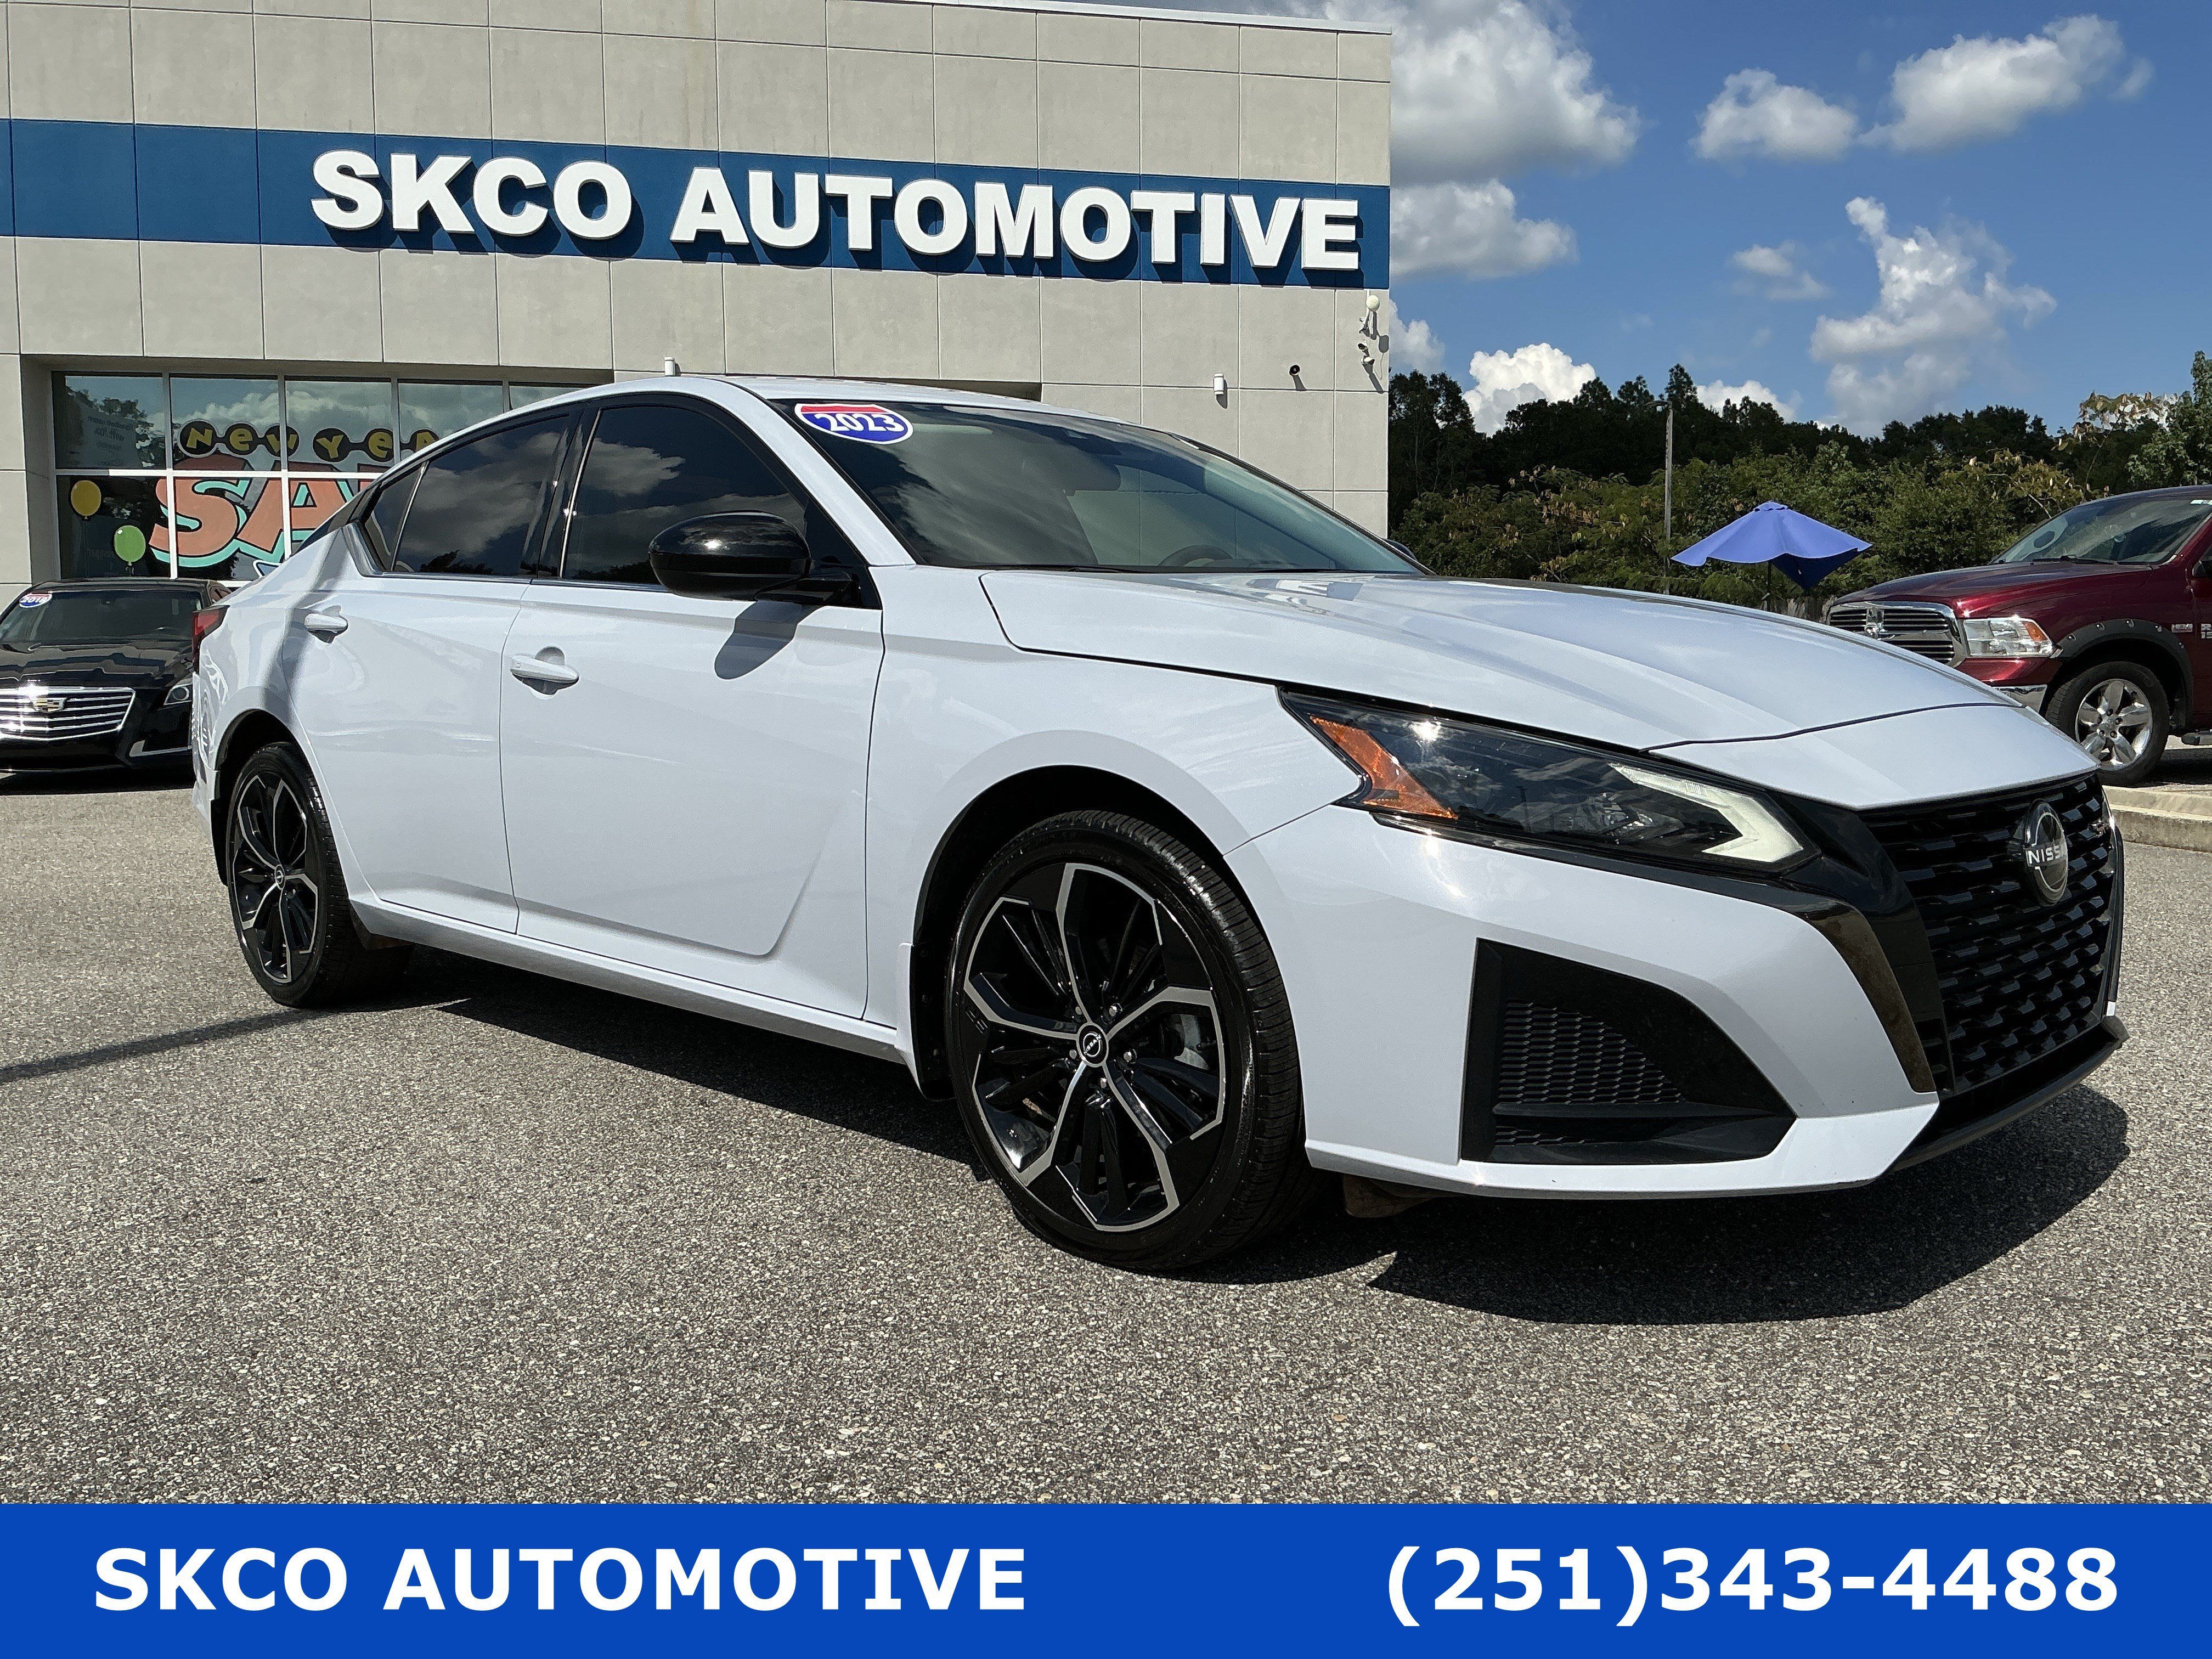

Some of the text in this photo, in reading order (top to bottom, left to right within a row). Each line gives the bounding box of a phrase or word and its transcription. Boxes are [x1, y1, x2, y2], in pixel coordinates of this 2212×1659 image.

[311, 149, 1359, 271] SKCO AUTOMOTIVE
[814, 413, 905, 432] 2023
